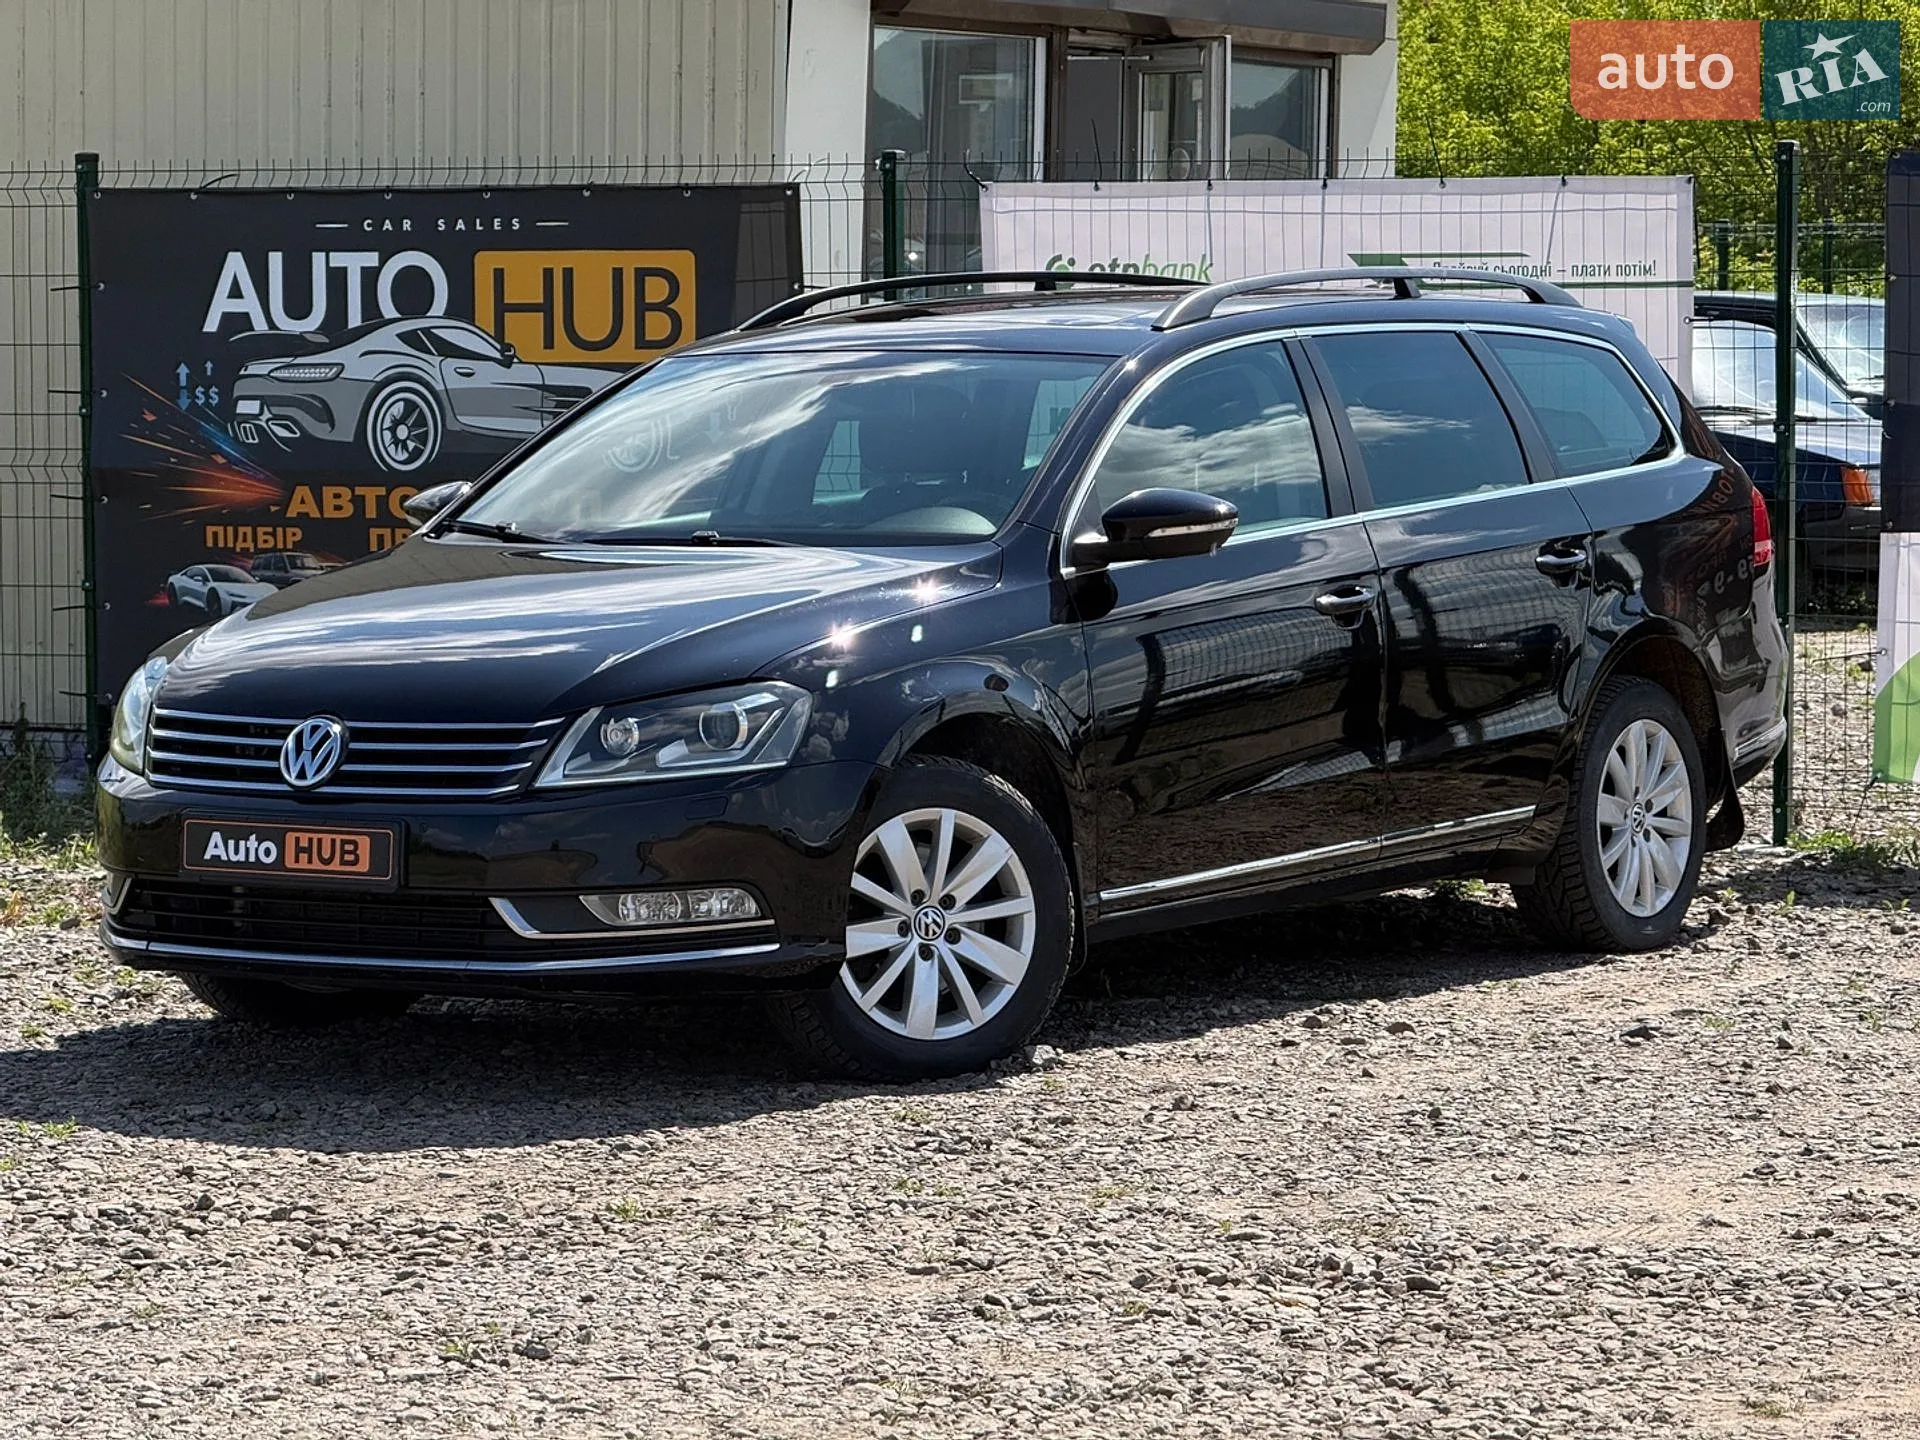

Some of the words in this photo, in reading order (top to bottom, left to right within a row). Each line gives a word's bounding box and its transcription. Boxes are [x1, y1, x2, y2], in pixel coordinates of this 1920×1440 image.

[363, 219, 412, 232] CAR
[437, 218, 521, 231] SALES
[1571, 263, 1611, 278] плати
[1616, 259, 1656, 277] потім!
[202, 250, 449, 333] AUTO
[493, 266, 683, 351] HUB
[205, 525, 303, 552] ПІДБІР
[203, 831, 278, 864] Auto
[293, 835, 361, 867] HUB
